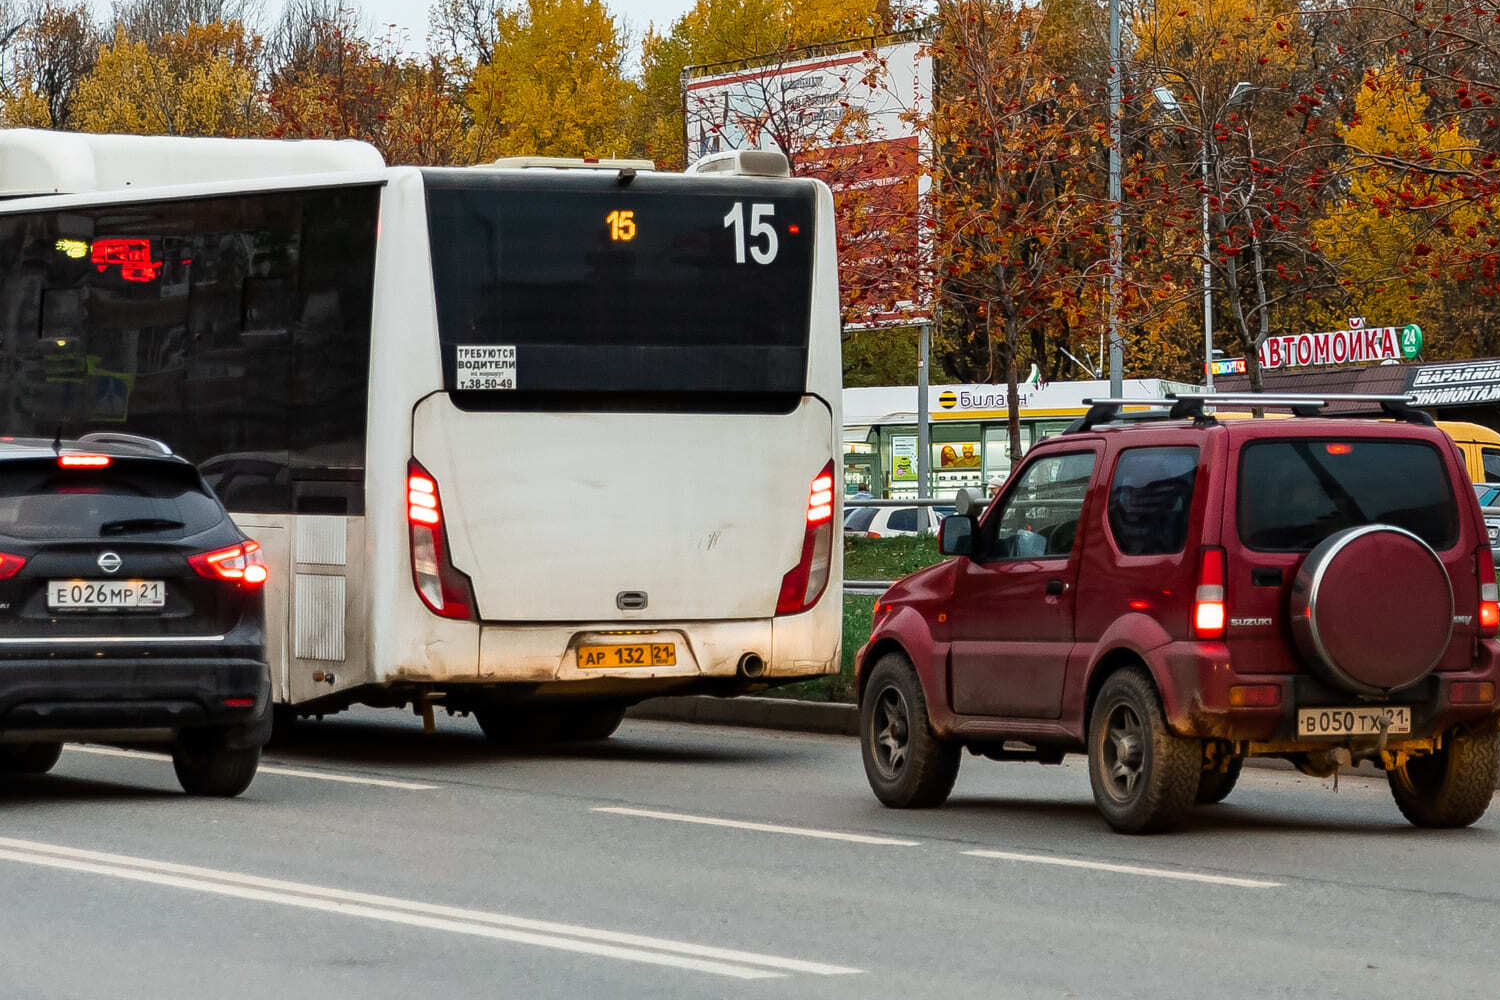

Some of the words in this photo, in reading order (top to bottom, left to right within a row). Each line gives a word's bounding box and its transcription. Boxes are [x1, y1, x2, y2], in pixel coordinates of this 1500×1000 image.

[912, 53, 921, 113] OVID-1
[606, 210, 636, 241] 15
[723, 202, 779, 265] 15
[1258, 317, 1396, 369] АВТОМОЙКА
[1403, 328, 1416, 345] 24
[458, 348, 515, 359] ТРЕБУЮТСЯ
[458, 360, 516, 371] ВОДИТЕЛИ
[960, 391, 1027, 408] Билан
[140, 584, 158, 598] 21
[1230, 617, 1272, 626] SUZUKI
[615, 648, 645, 664] 132
[654, 646, 670, 659] 21
